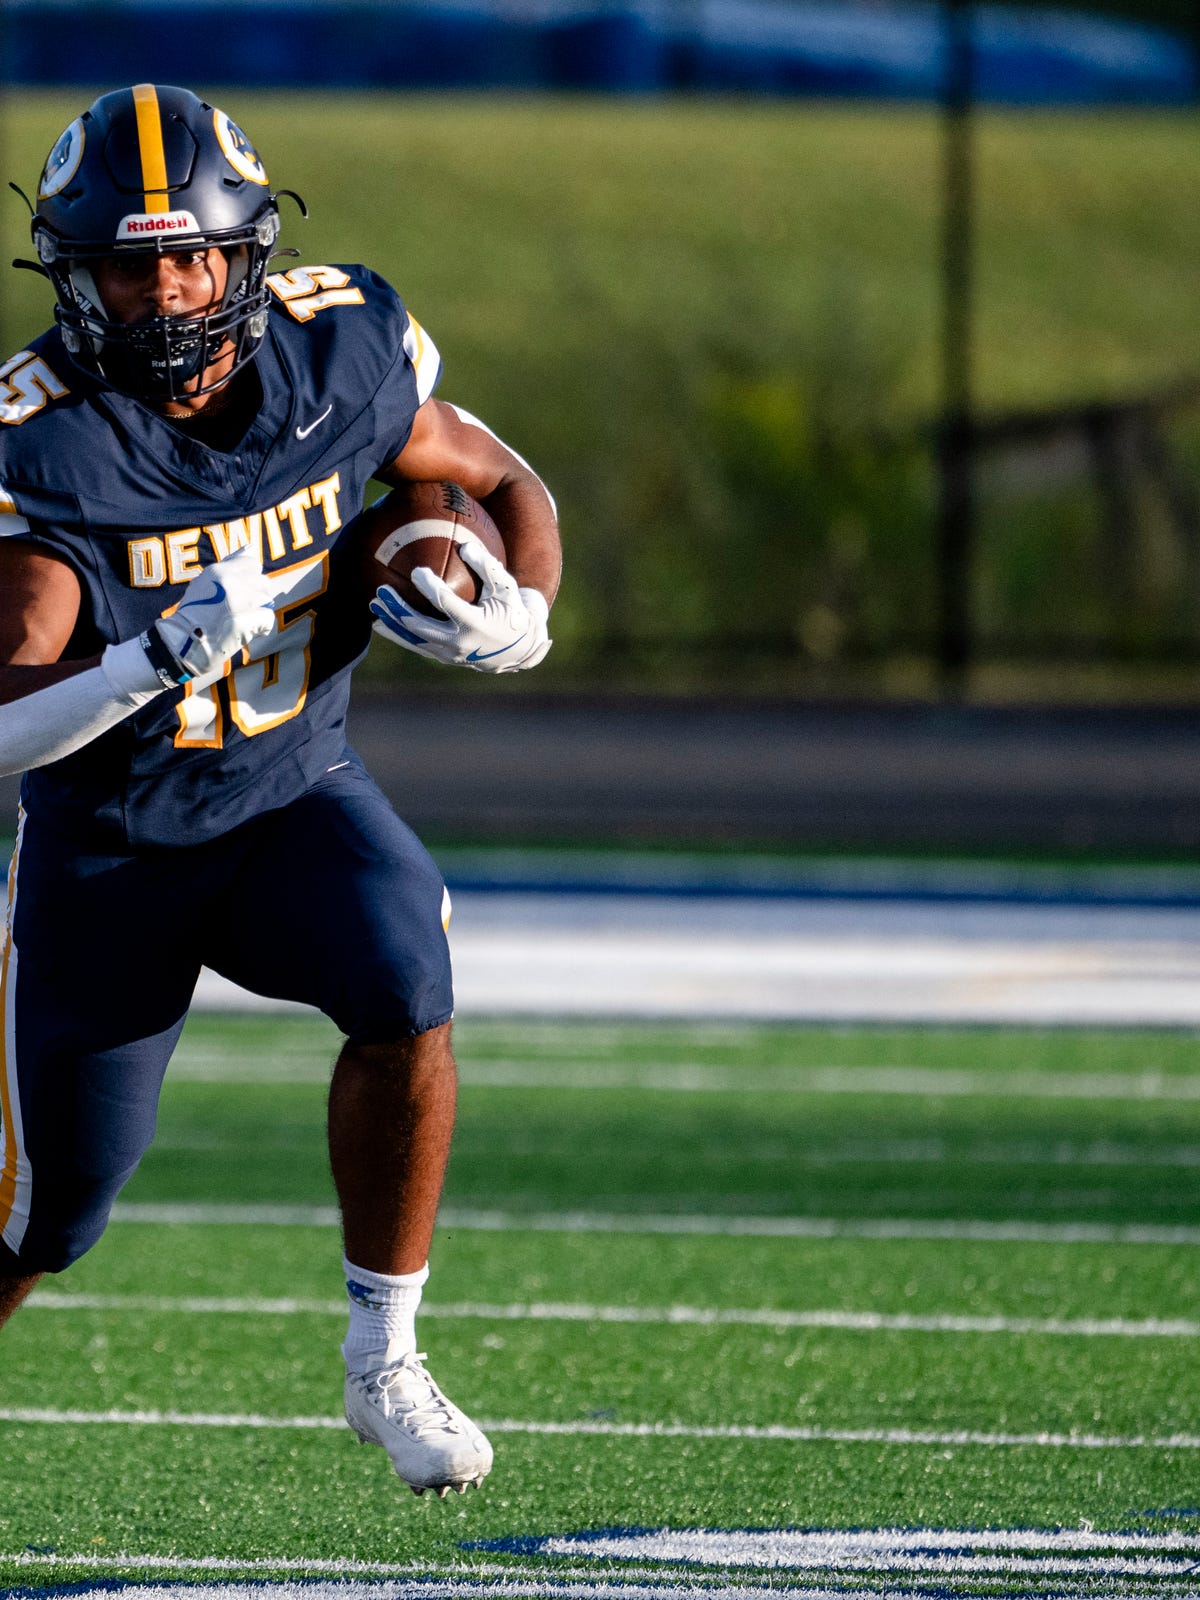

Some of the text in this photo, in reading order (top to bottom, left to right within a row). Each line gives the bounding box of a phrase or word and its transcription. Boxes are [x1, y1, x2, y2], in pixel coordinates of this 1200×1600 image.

[127, 217, 188, 232] Riddell
[265, 265, 366, 323] 15
[127, 471, 343, 588] DEWITT
